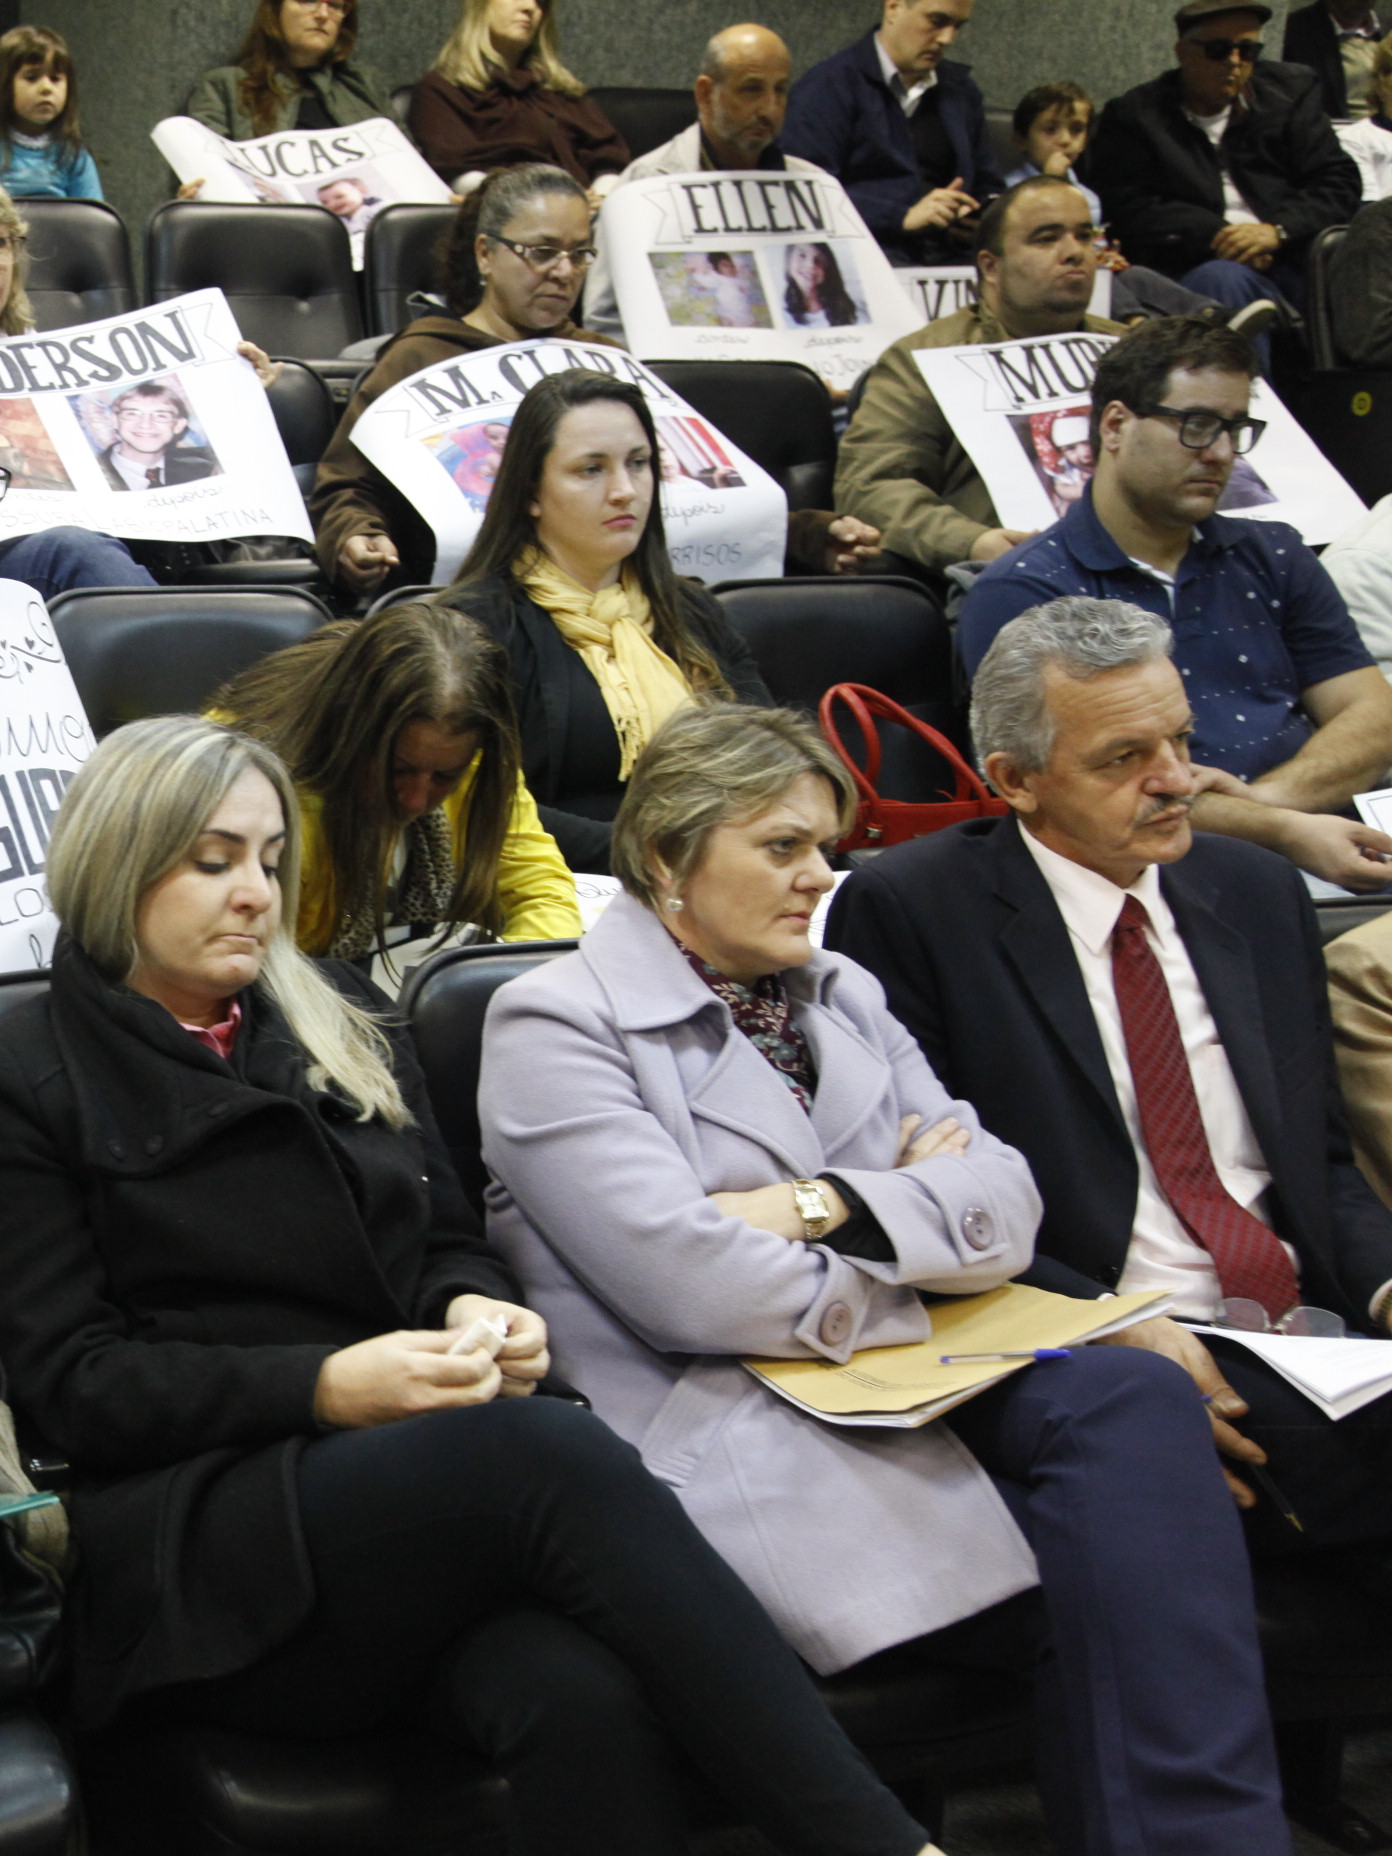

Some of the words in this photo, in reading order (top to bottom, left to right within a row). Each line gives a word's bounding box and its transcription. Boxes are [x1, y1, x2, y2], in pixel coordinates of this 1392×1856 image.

[681, 179, 825, 234] ELLEN
[917, 279, 981, 321] VIN
[988, 337, 1108, 404] MUR
[670, 541, 743, 567] RRISOS
